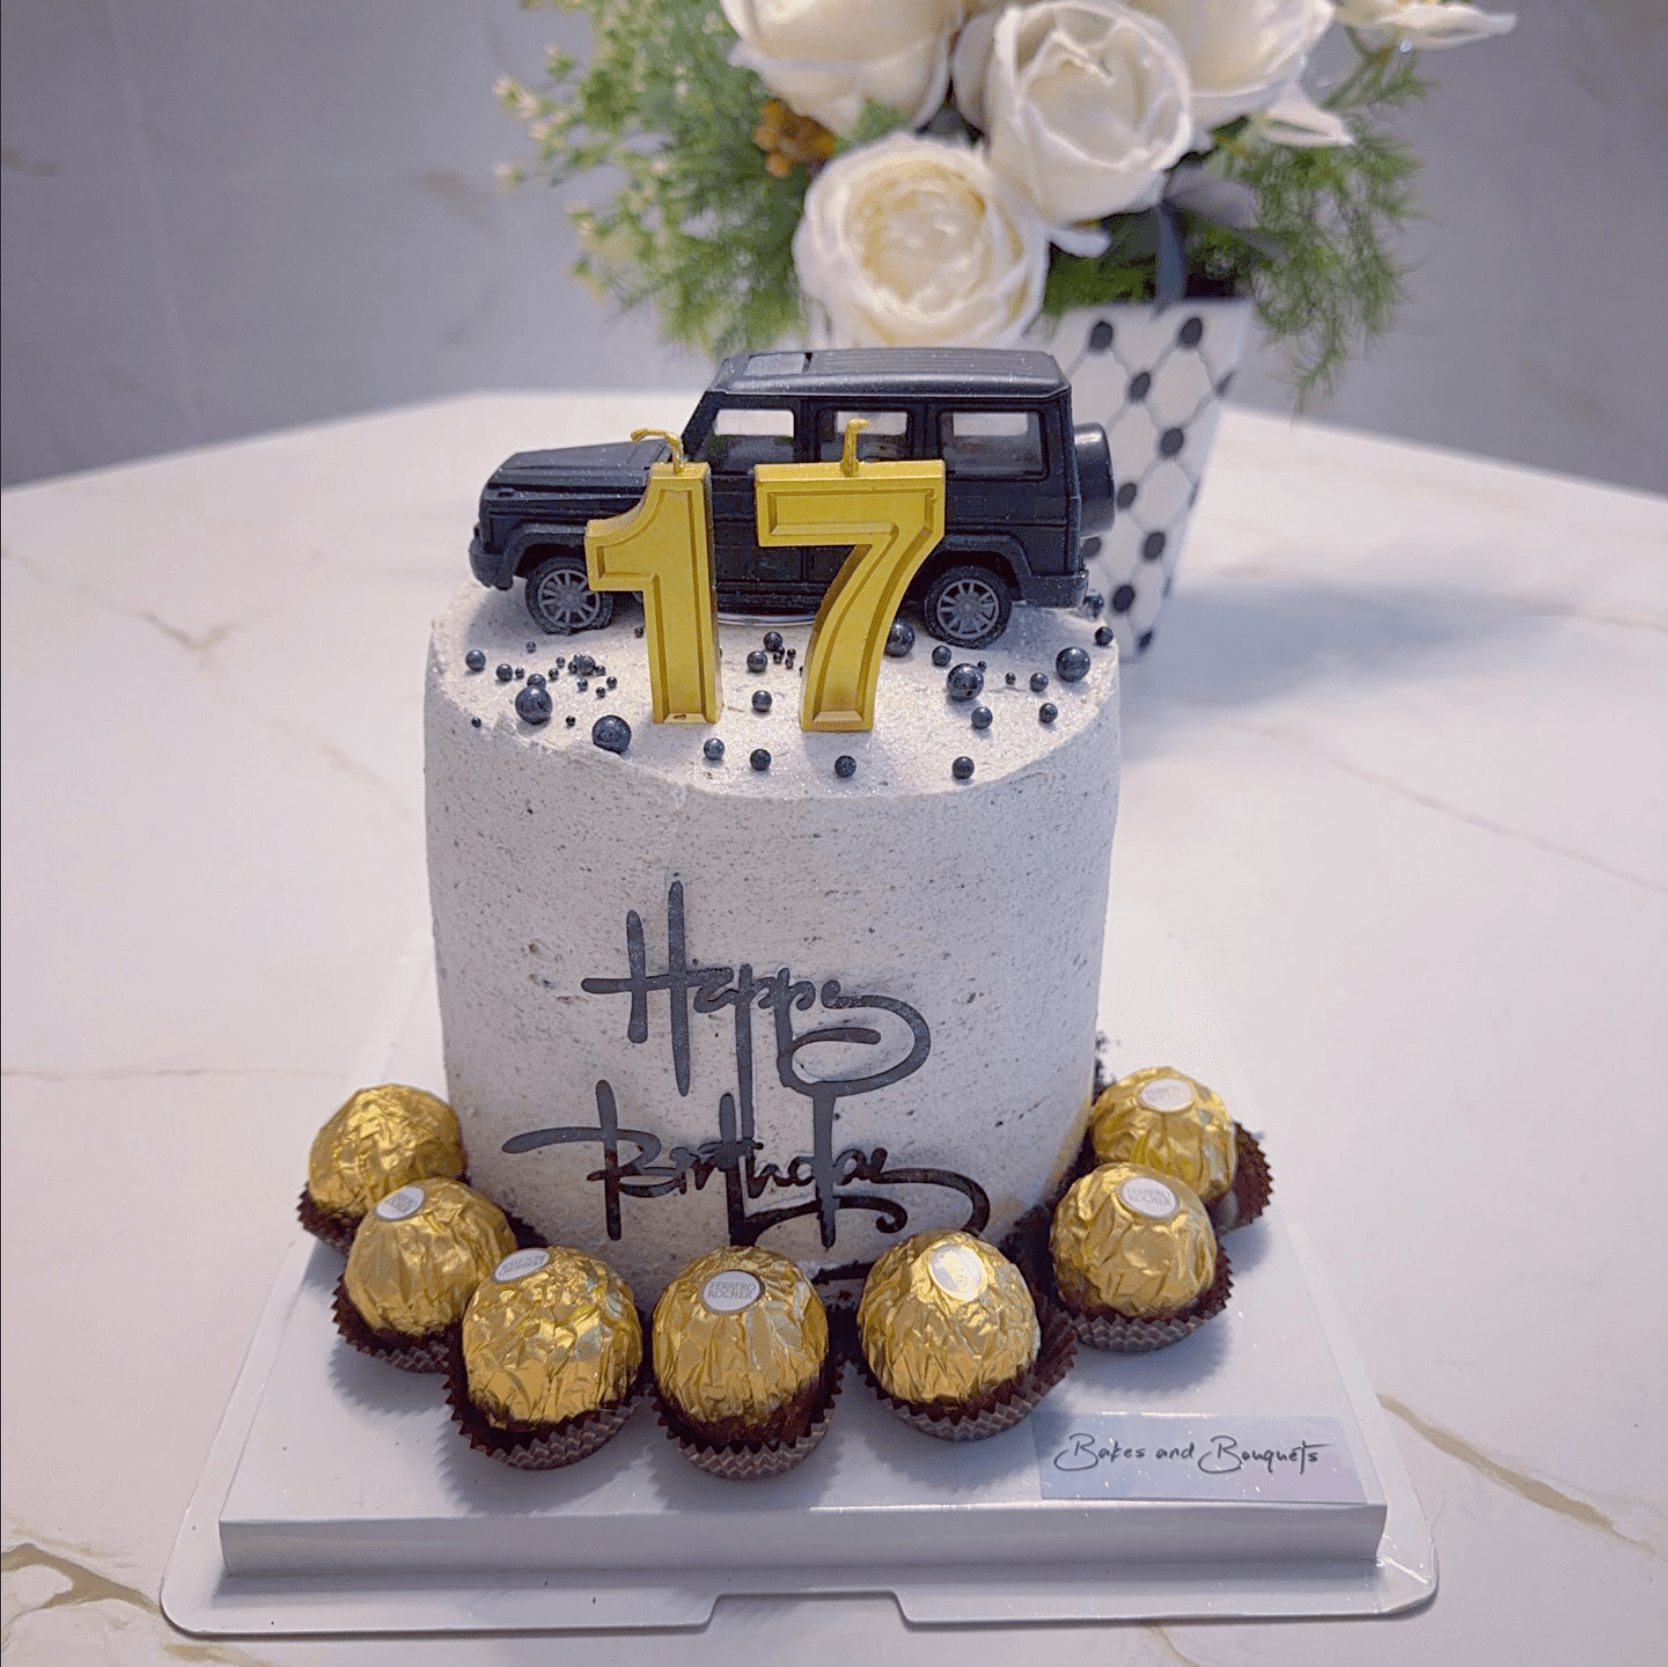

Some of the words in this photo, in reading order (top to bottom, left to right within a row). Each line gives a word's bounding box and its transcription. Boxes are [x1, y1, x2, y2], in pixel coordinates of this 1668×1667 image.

[585, 461, 946, 733] 17
[581, 880, 932, 1100] Happy
[502, 1079, 991, 1256] Birthday
[707, 1290, 753, 1299] ROCHER
[709, 1281, 757, 1291] FERRERO
[1053, 1432, 1146, 1471] Bakes
[1155, 1442, 1195, 1460] and
[1197, 1435, 1332, 1475] Bouquets
